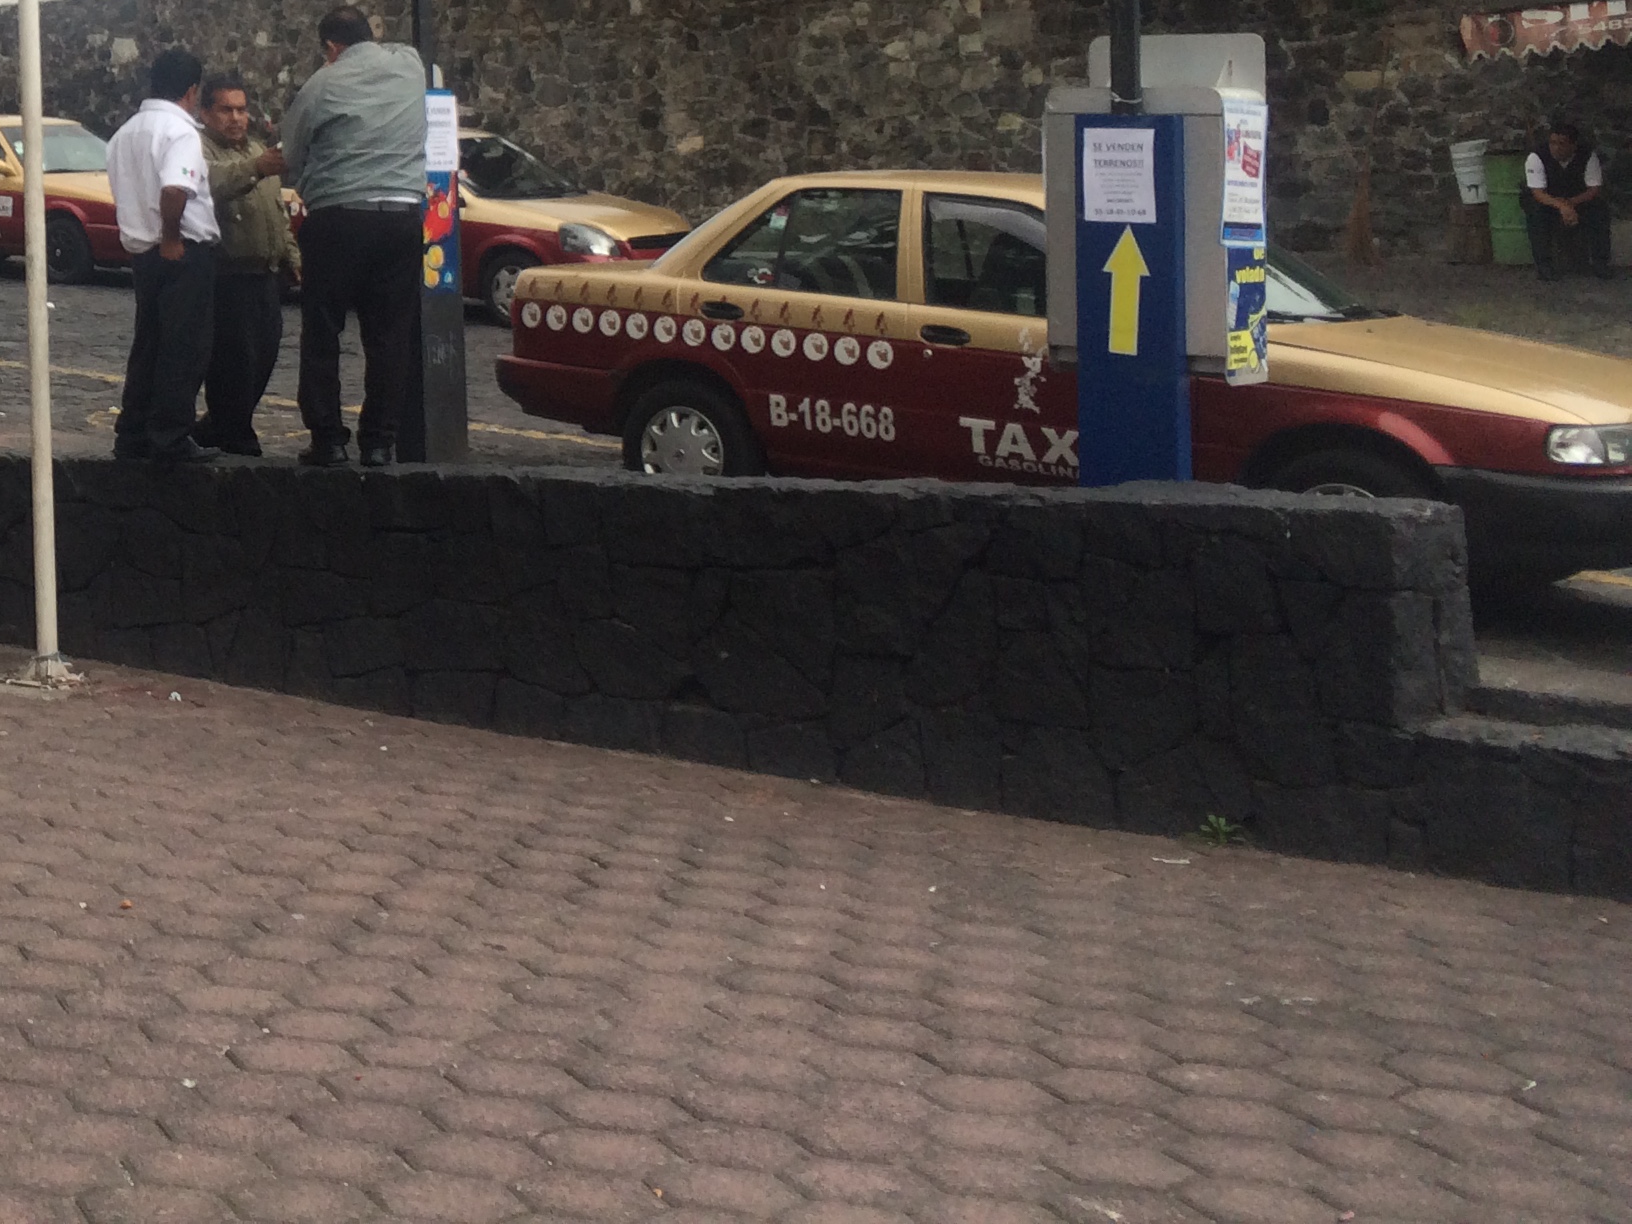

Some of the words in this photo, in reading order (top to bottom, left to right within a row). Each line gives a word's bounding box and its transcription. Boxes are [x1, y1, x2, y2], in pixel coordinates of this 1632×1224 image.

[1106, 142, 1144, 152] VENDEN
[769, 393, 896, 442] B-18-668
[959, 416, 1080, 467] TAX
